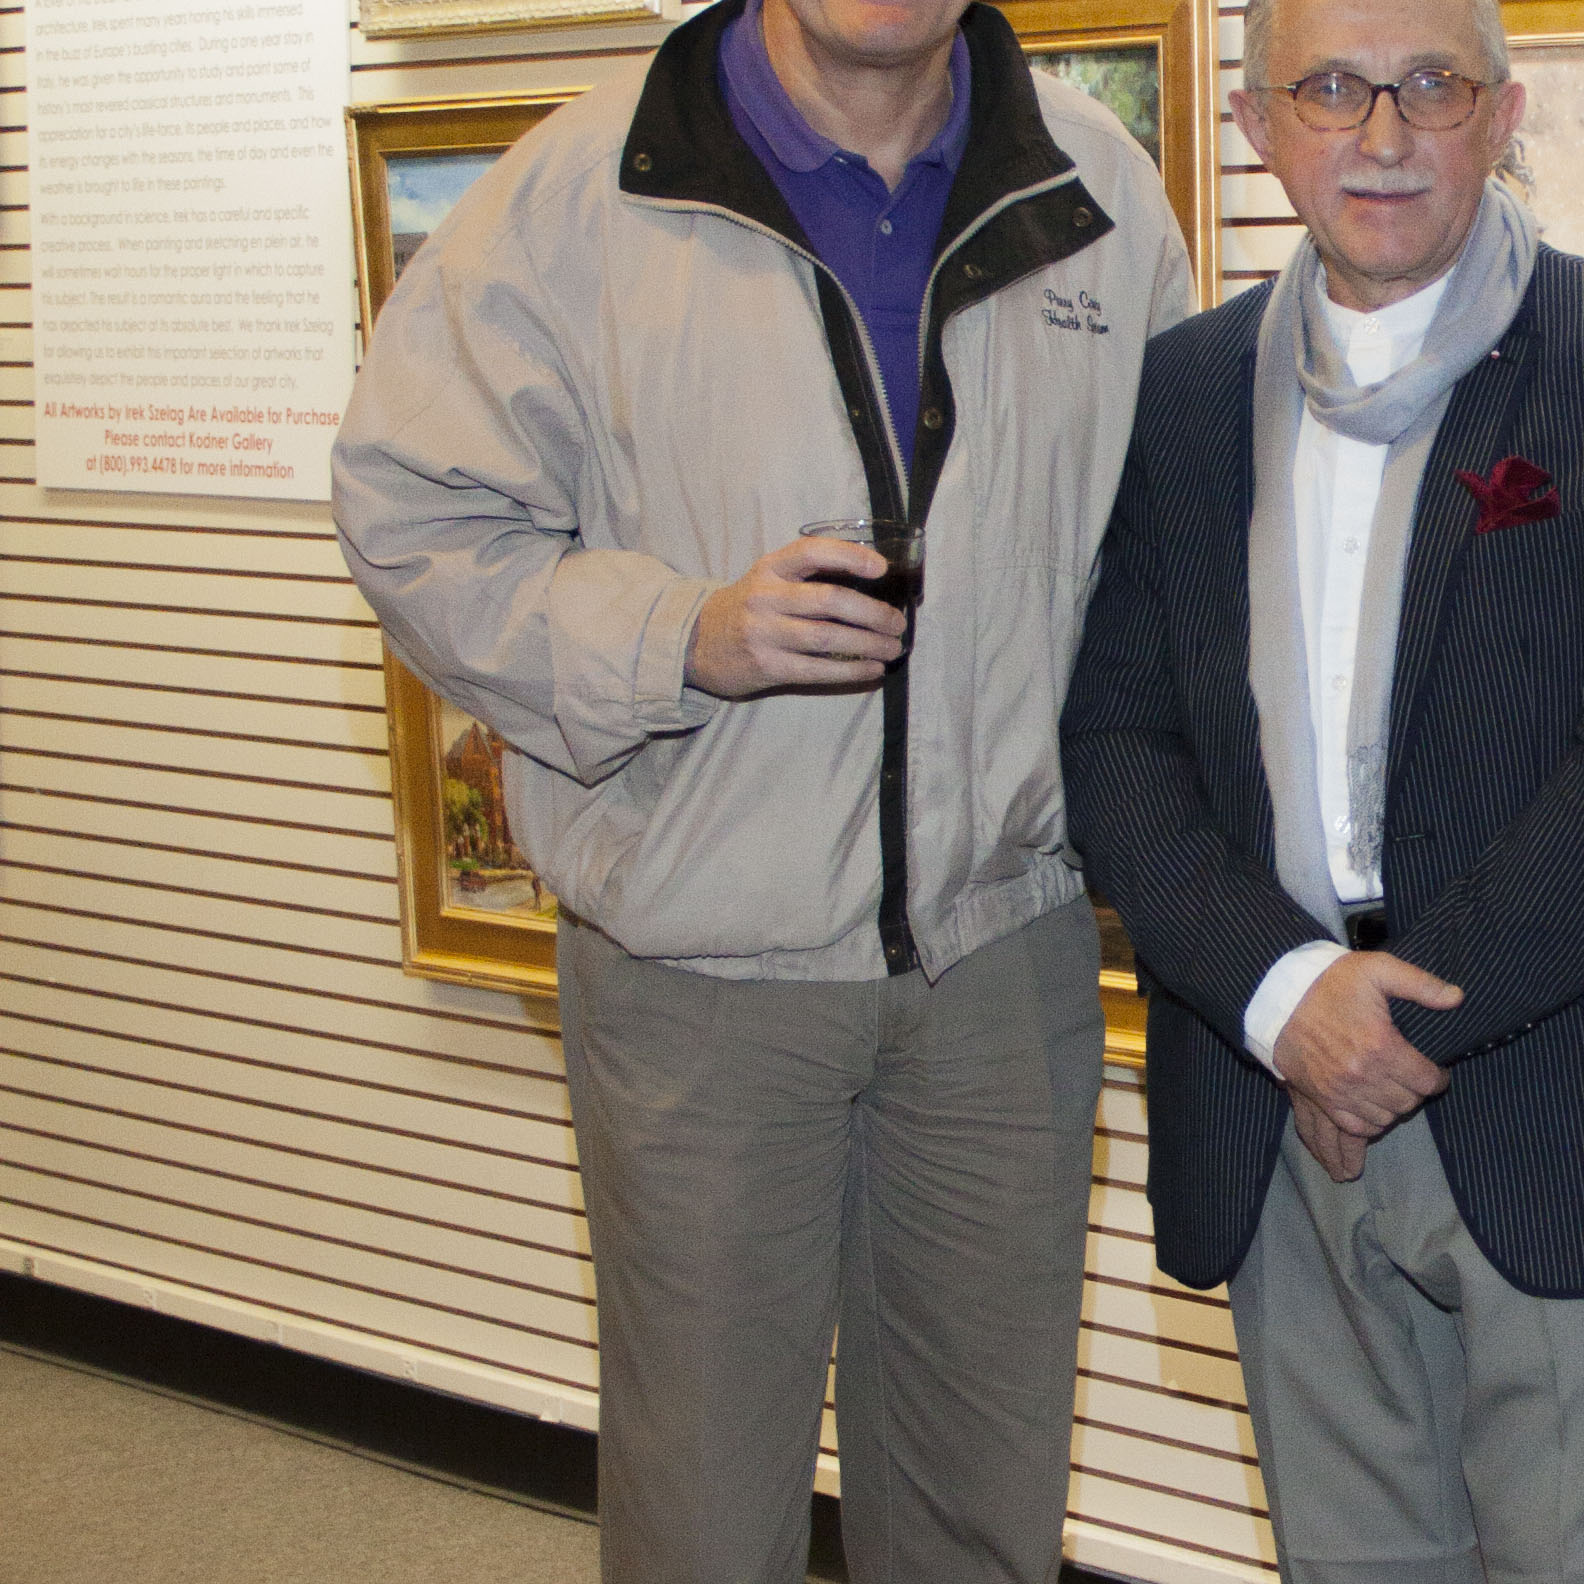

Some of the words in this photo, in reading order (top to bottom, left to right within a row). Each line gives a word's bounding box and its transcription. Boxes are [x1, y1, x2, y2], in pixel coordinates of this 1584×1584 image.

[44, 401, 58, 417] All
[60, 402, 105, 418] Artworks
[107, 403, 123, 423] by
[124, 403, 145, 419] Irek
[147, 404, 184, 424] Szelag
[186, 405, 207, 420] Are
[209, 406, 264, 422] Available
[266, 407, 283, 422] for
[286, 407, 340, 426] Purchase
[104, 429, 140, 445] Please
[141, 430, 186, 447] contact
[188, 432, 230, 448] Kodner
[231, 433, 273, 454] Gallery
[86, 456, 97, 472] at
[179, 458, 194, 473] for
[197, 463, 227, 477] more
[230, 460, 295, 479] information
